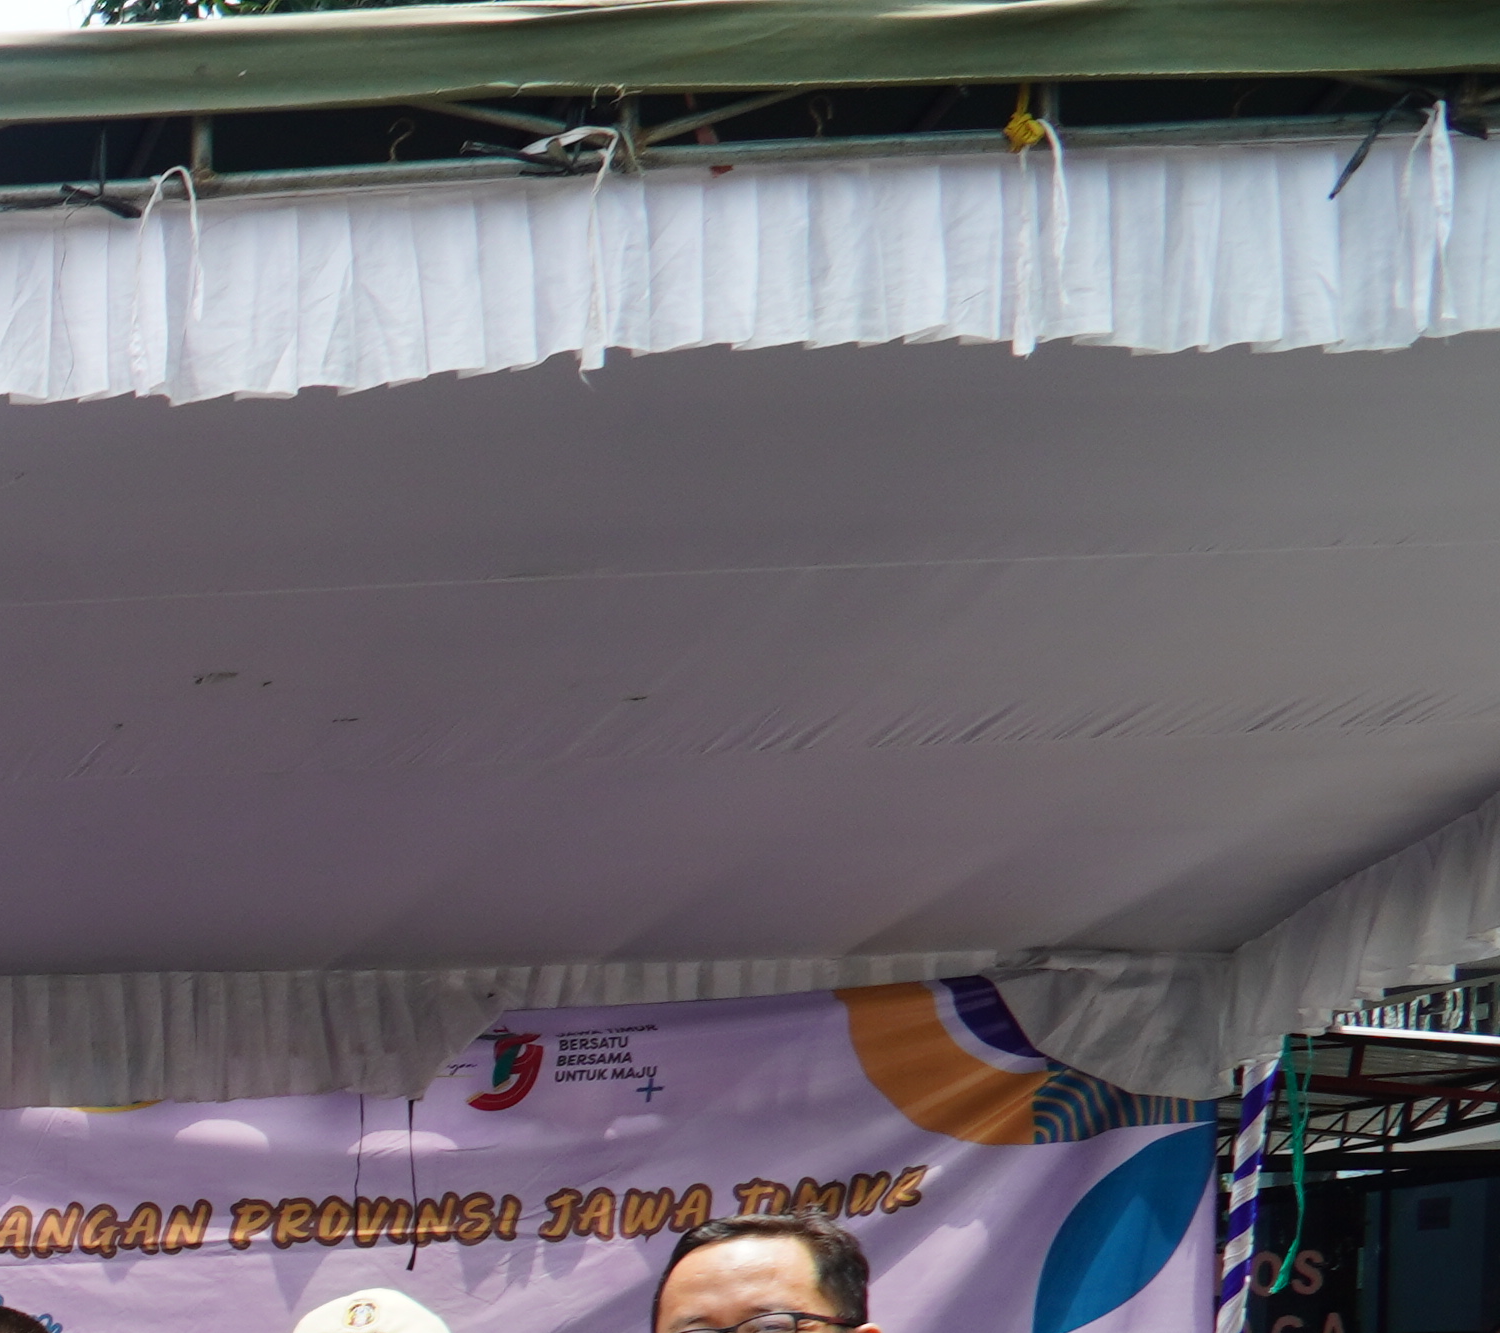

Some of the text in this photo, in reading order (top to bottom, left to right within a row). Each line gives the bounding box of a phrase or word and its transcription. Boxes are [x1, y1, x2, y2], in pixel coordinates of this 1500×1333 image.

[559, 1036, 629, 1051] BERSATU
[556, 1052, 633, 1067] BERSAMA
[554, 1066, 658, 1083] UNTUK MAJU
[229, 1190, 524, 1252] PROVINSI
[537, 1181, 717, 1245] JAWA
[732, 1164, 931, 1219] TIMUR
[1250, 1250, 1325, 1298] OS
